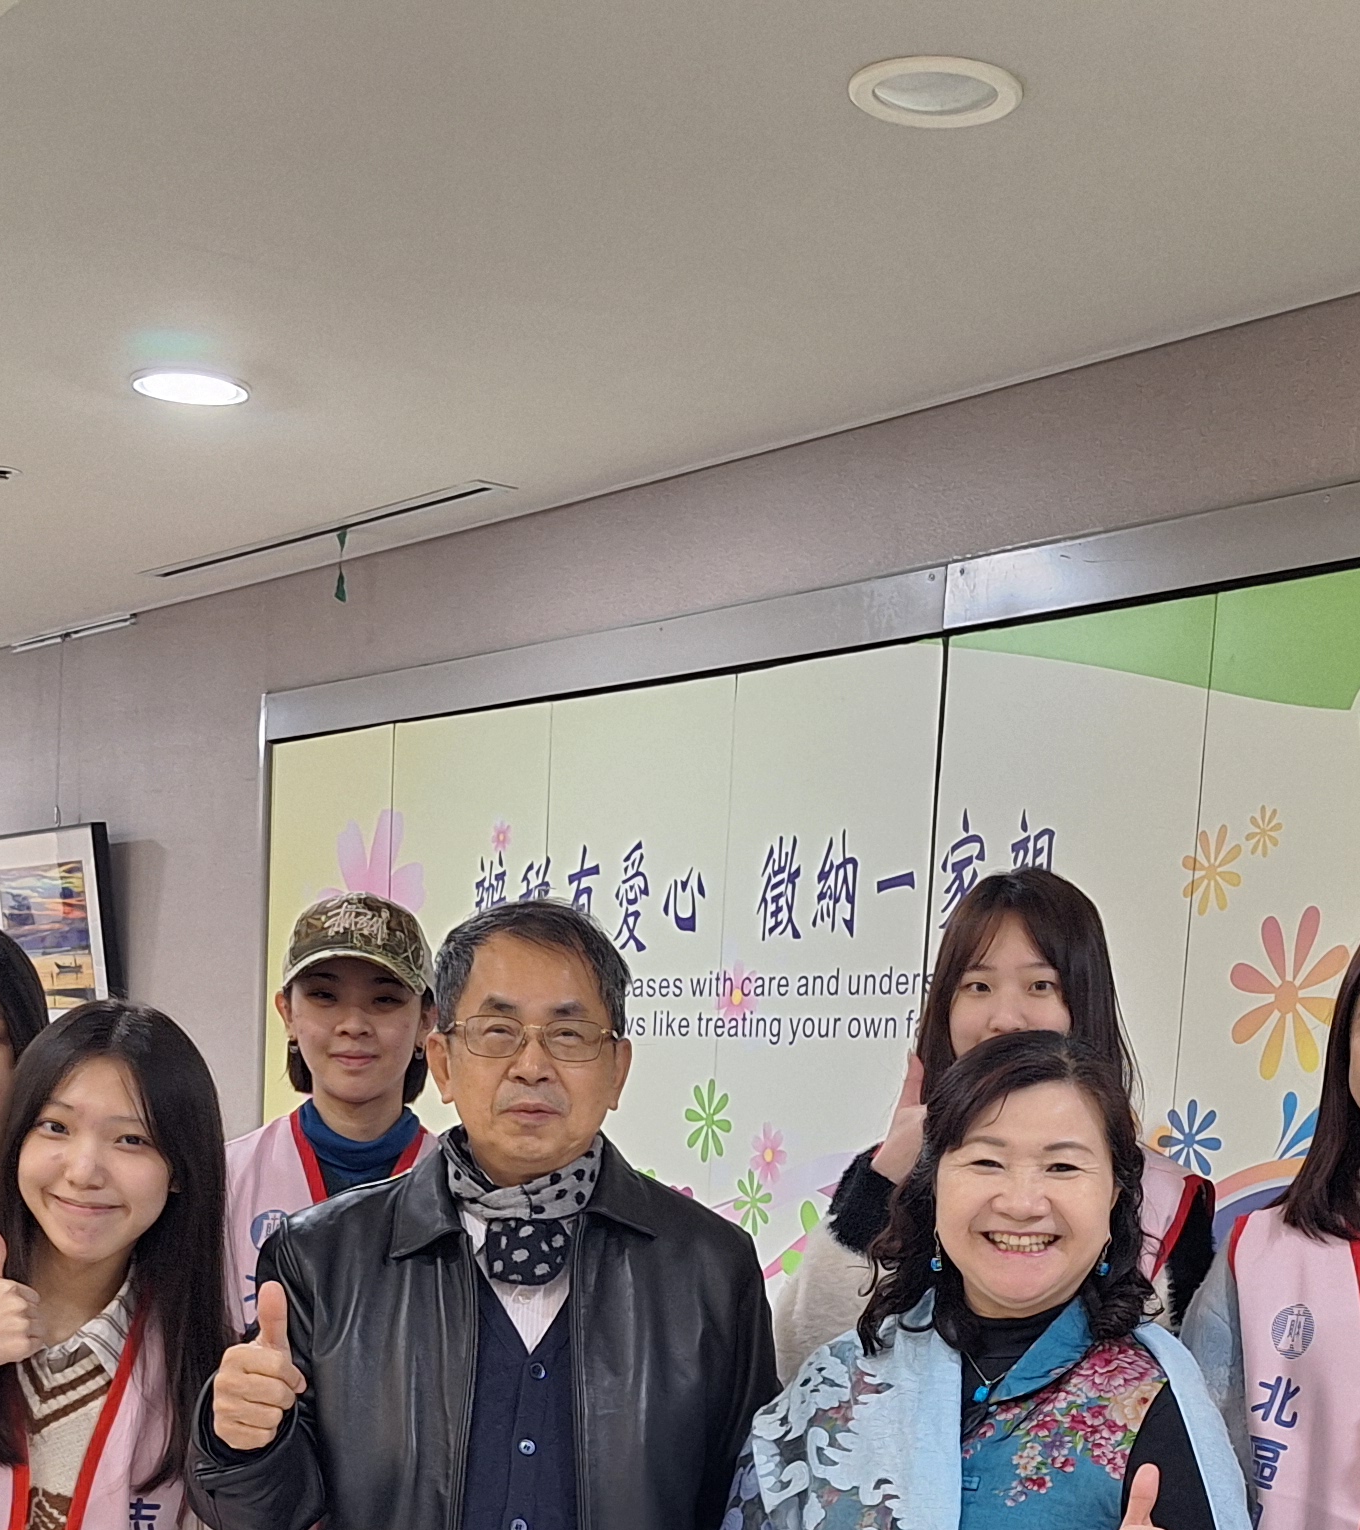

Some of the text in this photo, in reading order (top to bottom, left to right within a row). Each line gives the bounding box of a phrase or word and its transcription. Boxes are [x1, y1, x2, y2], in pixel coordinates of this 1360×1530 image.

[690, 969, 733, 997] with
[741, 976, 789, 997] care
[796, 967, 840, 996] and
[653, 1010, 690, 1037] like
[697, 1011, 781, 1046] treating
[788, 1017, 842, 1046] your
[848, 1017, 897, 1038] own
